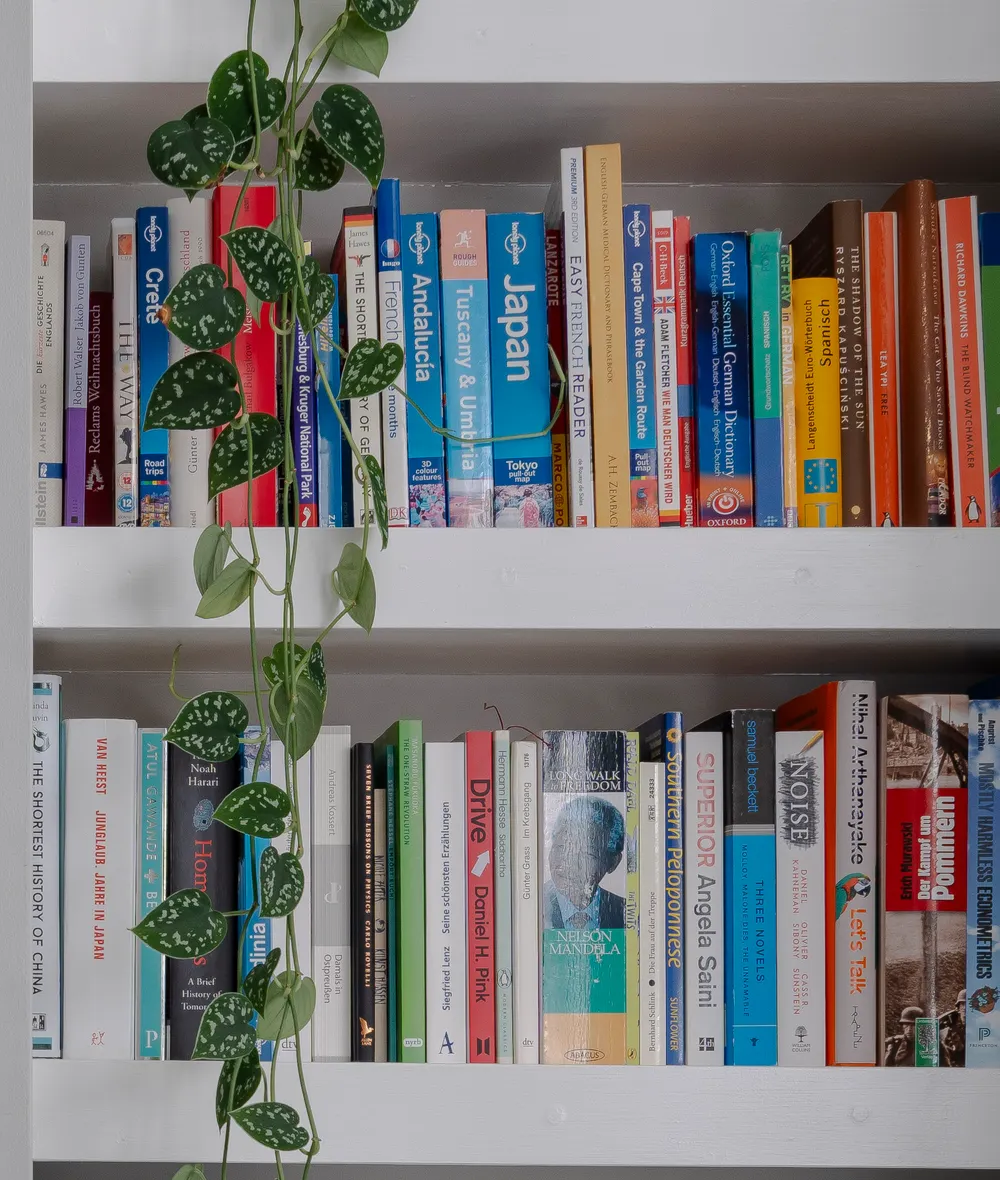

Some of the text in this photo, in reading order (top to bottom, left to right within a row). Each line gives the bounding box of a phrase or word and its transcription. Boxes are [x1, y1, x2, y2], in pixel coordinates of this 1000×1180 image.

[510, 221, 519, 265] lonely planet
[571, 212, 579, 243] EDITION
[76, 243, 85, 280] Gunten
[546, 236, 558, 306] LANZAROTE
[74, 303, 84, 330] Jakob
[145, 268, 163, 324] Crete
[384, 281, 402, 341] French
[677, 254, 689, 347] Kurzgrammatik Deutsch
[73, 336, 83, 369] Walser
[412, 273, 435, 382] Andalucía
[497, 274, 536, 382] Japan
[570, 255, 585, 438] EASY FRENCH READER
[631, 262, 647, 439] Cape Town & the Garden Route
[818, 299, 833, 367] Spanisch
[835, 246, 851, 430] RYSZARD KAPUŚCIŃSKI
[851, 246, 865, 429] THE SHADOW OF THE SUN
[955, 242, 974, 468] RICHARD DAWKINS THE BLIND WATCHMAKER
[88, 304, 101, 453] Reclams Weihnachtsbuch
[118, 321, 133, 420] THE WAY
[454, 285, 478, 470] Tuscany & Umbria
[721, 240, 738, 478] Oxford Essential German Dictionary
[764, 353, 772, 411] Grundwortschatz
[804, 299, 817, 450] Langenscheidt Euro-Wörterbuch
[879, 350, 888, 415] LEA YPI FREE
[39, 383, 47, 415] HAWES
[73, 371, 82, 405] Robert
[388, 394, 399, 439] months
[660, 318, 673, 504] ADAM FLETCHER WIE MAN DEUTSCHER WIRD
[144, 459, 165, 467] Road
[188, 436, 197, 473] Günter
[297, 375, 312, 499] & Kruger National Park
[505, 460, 538, 470] Tokyo
[145, 468, 164, 476] trips
[553, 443, 562, 492] MARCO
[707, 518, 746, 527] OXFORD
[96, 737, 108, 759] VAN
[987, 719, 996, 745] Angrist
[95, 764, 107, 795] HEEST
[188, 777, 219, 787] Harari
[190, 763, 216, 773] Noah
[549, 770, 621, 781] LONG WALK
[560, 780, 622, 791] FREEDOM
[746, 720, 759, 813] samuel beckett
[847, 693, 868, 865] Nihal Arthanayake
[146, 742, 158, 861] ATUL GAWANDE
[329, 806, 337, 836] Kossert
[498, 750, 507, 878] Hermann Hesse Siddhartha
[790, 760, 809, 841] NOISE
[667, 751, 683, 969] Southern Peloponnese
[931, 795, 956, 901] Pommern
[976, 762, 995, 980] MOSTLY HARMLESS ECONOMETRICS
[32, 761, 43, 995] THE SHORTEST HISTORY OF CHINA
[94, 872, 106, 905] JAHRE
[441, 801, 452, 1010] Siegfried Lenz Seine schönsten Erzählungen
[470, 779, 492, 1003] Drive Daniel H. Pink
[694, 752, 717, 1007] SUPERIOR Angela Saini
[800, 869, 808, 904] DANIEL
[93, 925, 105, 960] JAPAN
[94, 909, 105, 921] IN
[556, 930, 613, 942] NELSON
[755, 880, 765, 982] THREE NOVELS
[792, 923, 800, 959] SIBONY
[549, 943, 621, 955] MANDELA
[850, 908, 867, 995] Let's Talk
[322, 954, 332, 1004] Ostpreußen
[648, 991, 656, 1017] Schlink
[792, 968, 800, 1015] SUNSTEIN
[670, 997, 678, 1051] SUNFLOWER
